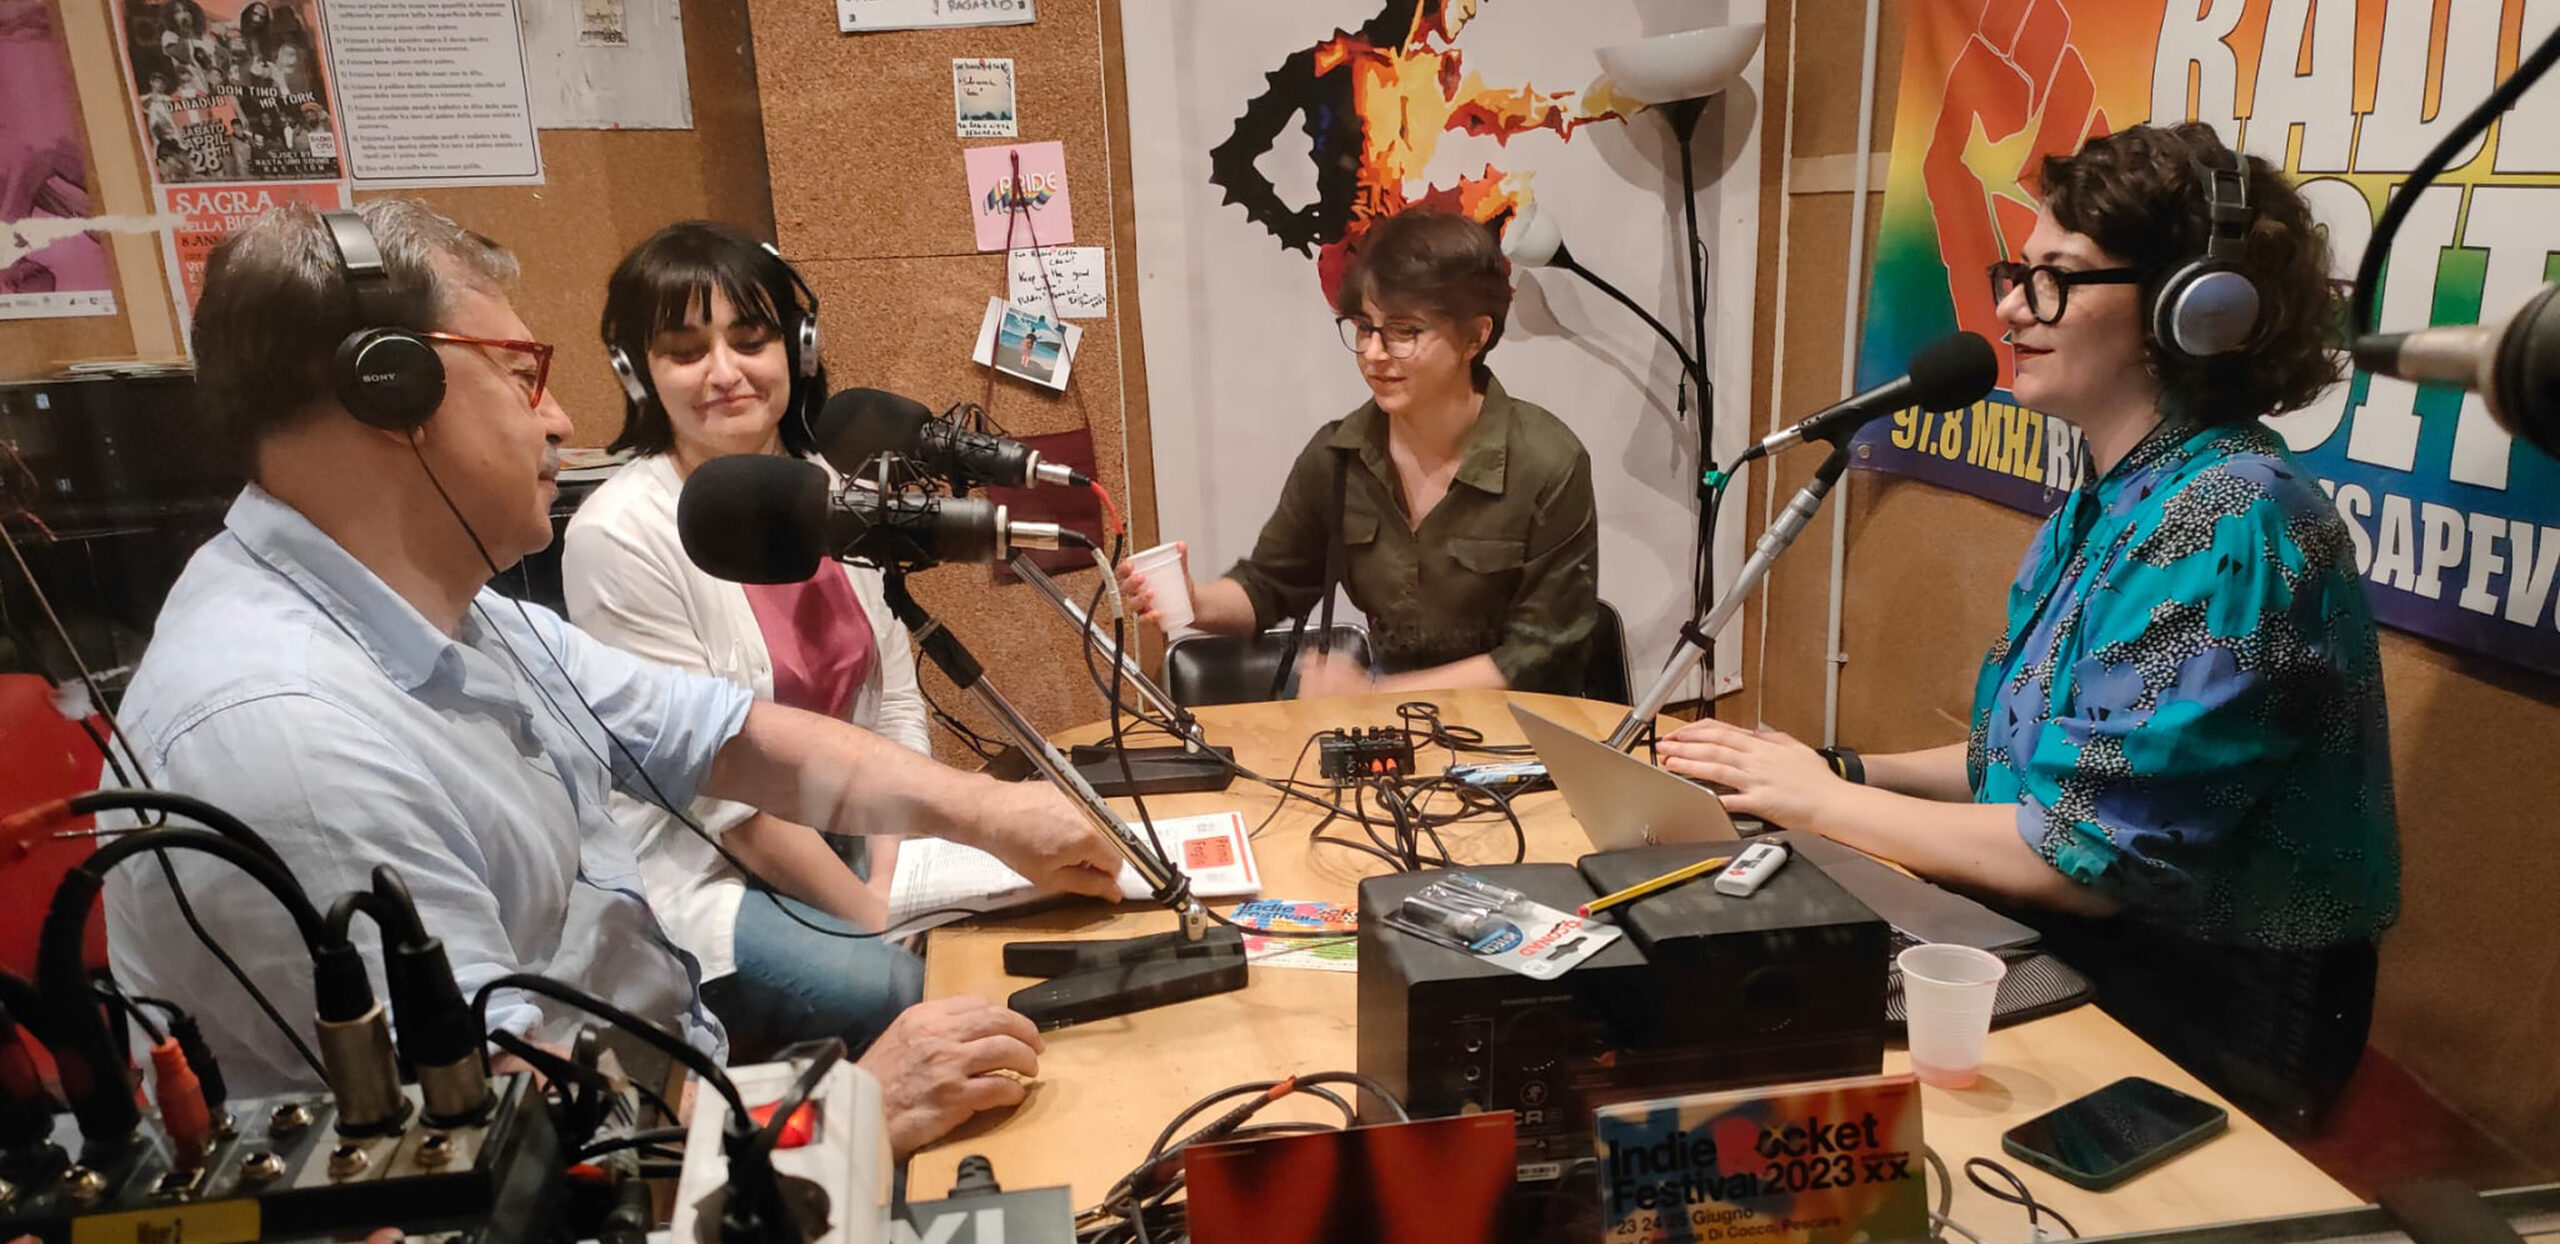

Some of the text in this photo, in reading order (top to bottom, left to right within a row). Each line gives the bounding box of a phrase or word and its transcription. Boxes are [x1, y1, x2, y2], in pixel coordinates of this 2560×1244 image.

[182, 134, 228, 150] APRIL
[176, 190, 273, 215] SAGRA
[362, 372, 396, 382] SONY
[1967, 400, 2044, 483] MHZ
[2318, 477, 2560, 632] SAPEV
[1609, 1131, 1718, 1180] Indie
[1612, 1171, 1758, 1212] Festival
[1764, 1154, 1856, 1195] 2023
[1617, 1219, 1637, 1235] 23
[1693, 1207, 1754, 1226] Giugno
